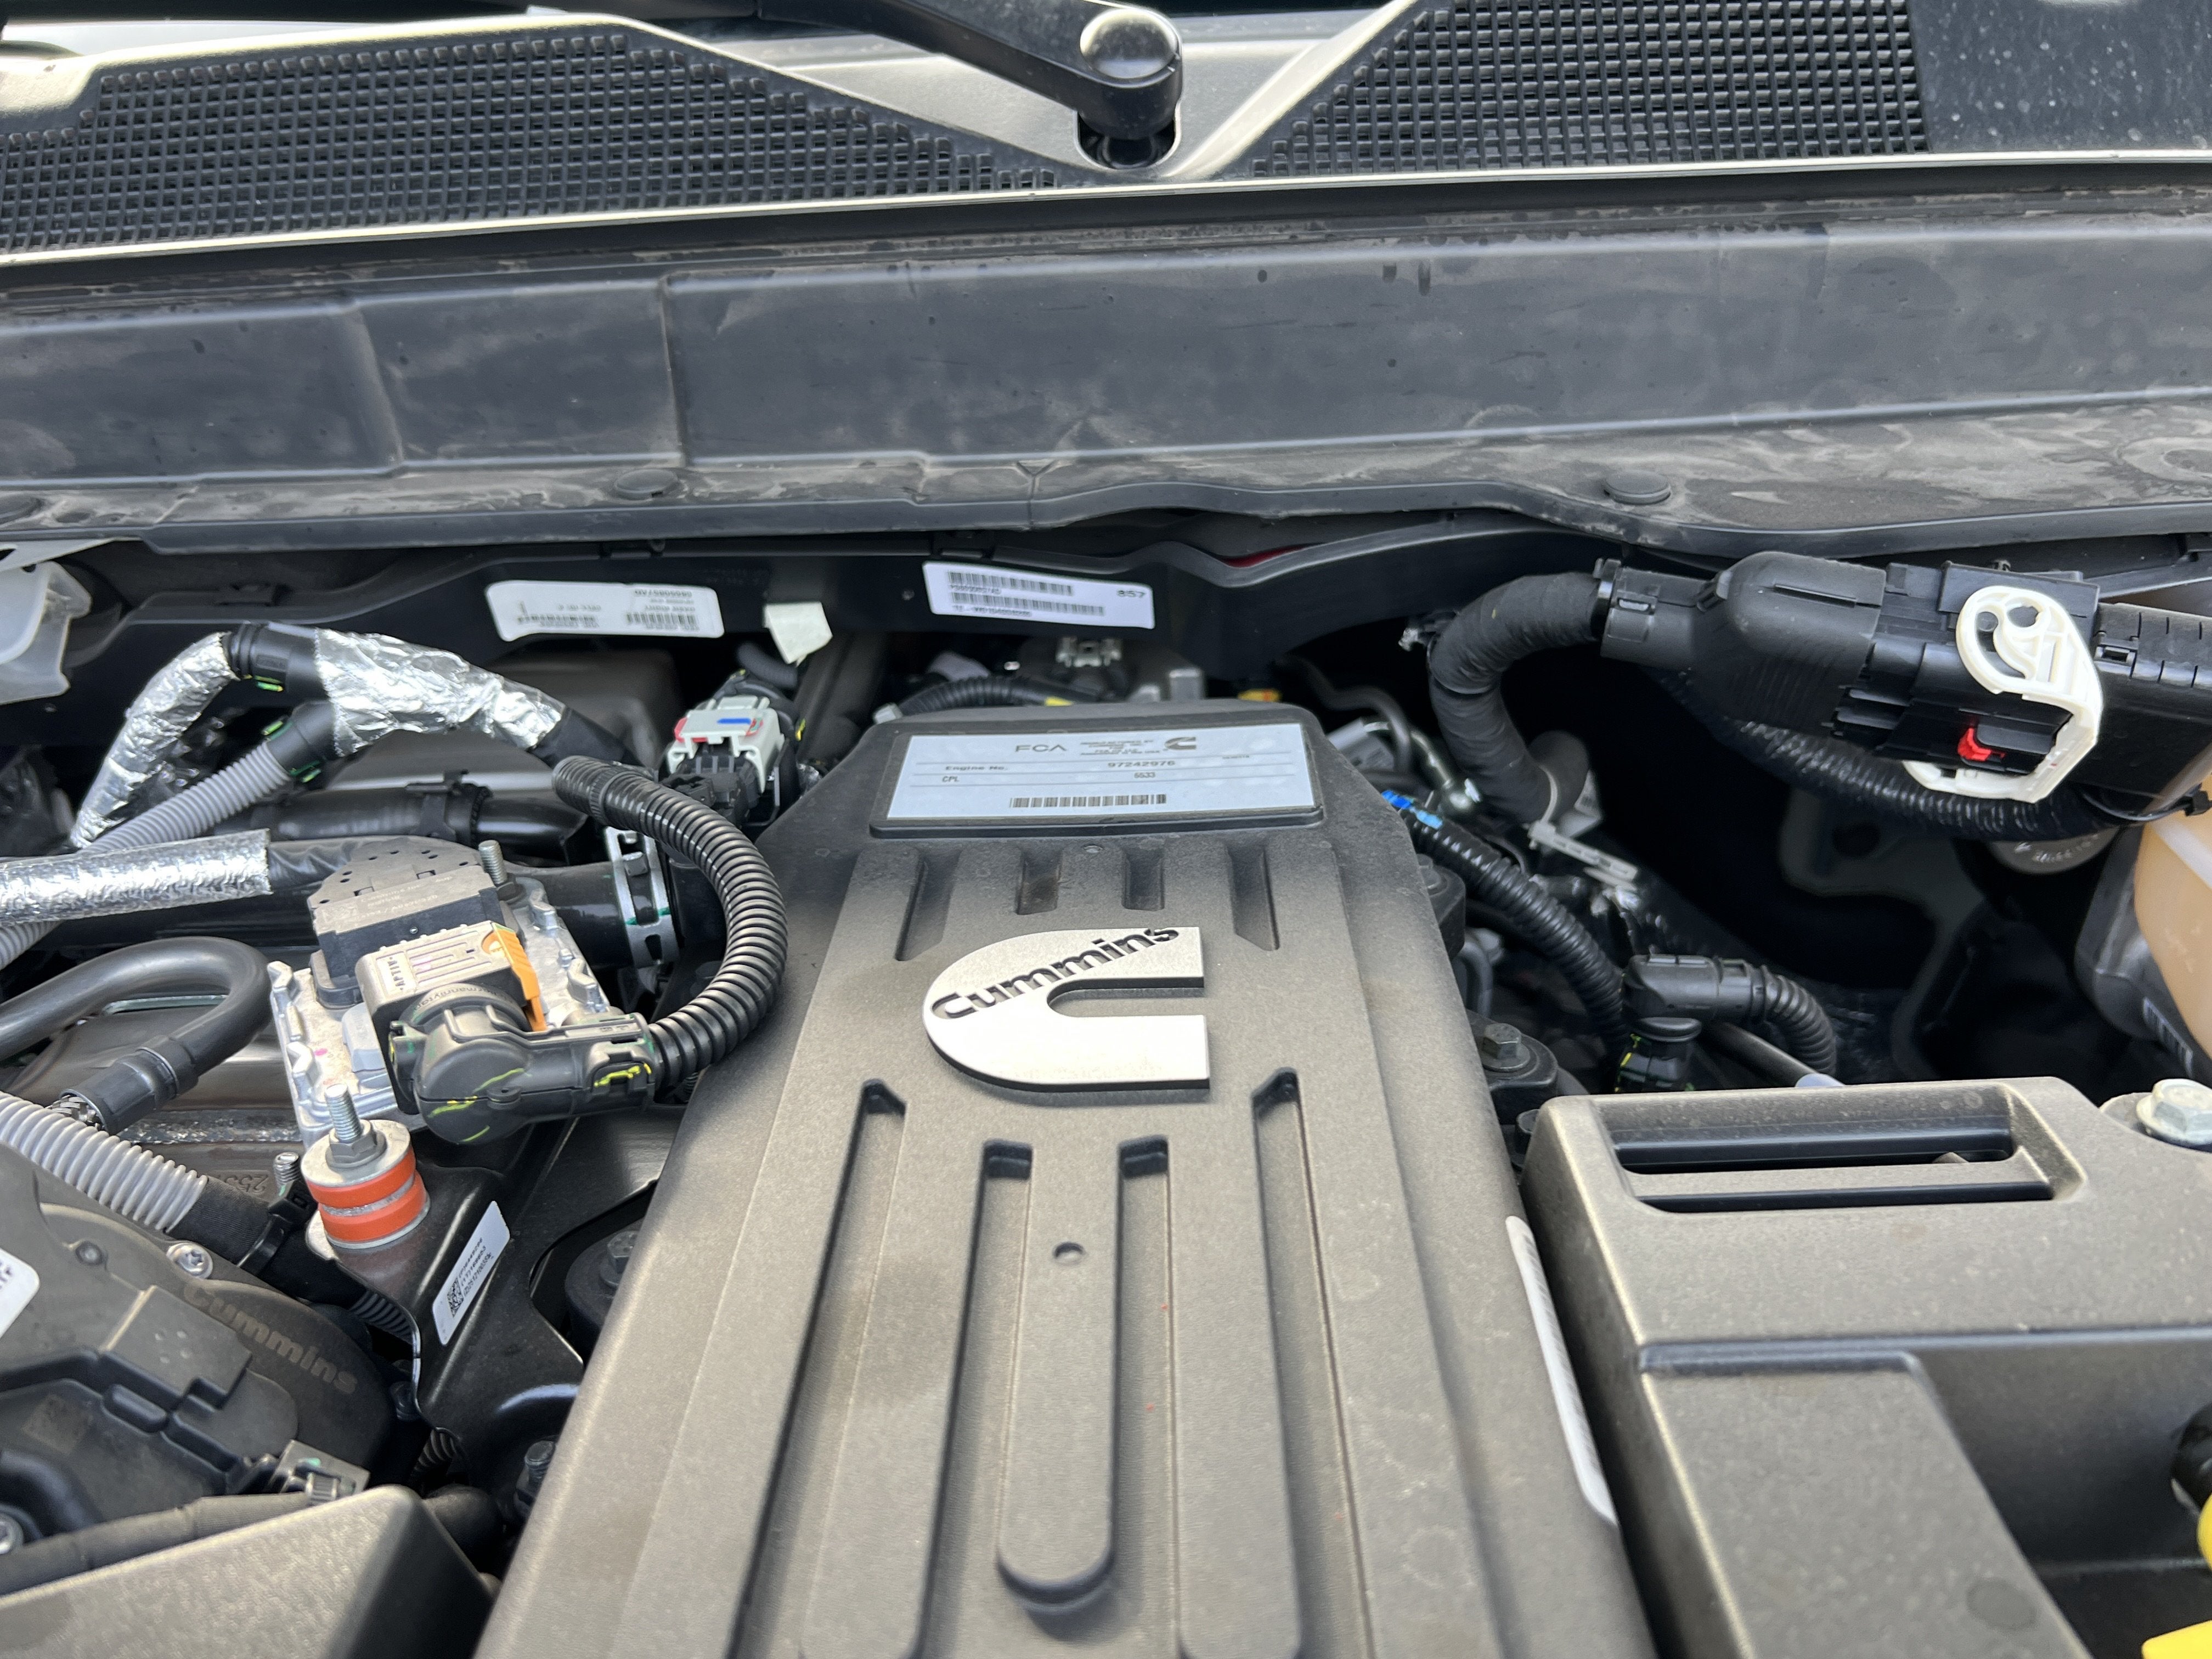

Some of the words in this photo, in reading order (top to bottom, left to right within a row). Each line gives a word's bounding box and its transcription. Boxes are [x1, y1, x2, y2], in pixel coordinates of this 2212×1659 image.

[1116, 590, 1146, 599] 857
[388, 960, 406, 987] APTIV
[930, 928, 1179, 1019] Cummins
[184, 1286, 357, 1394] Cummins
